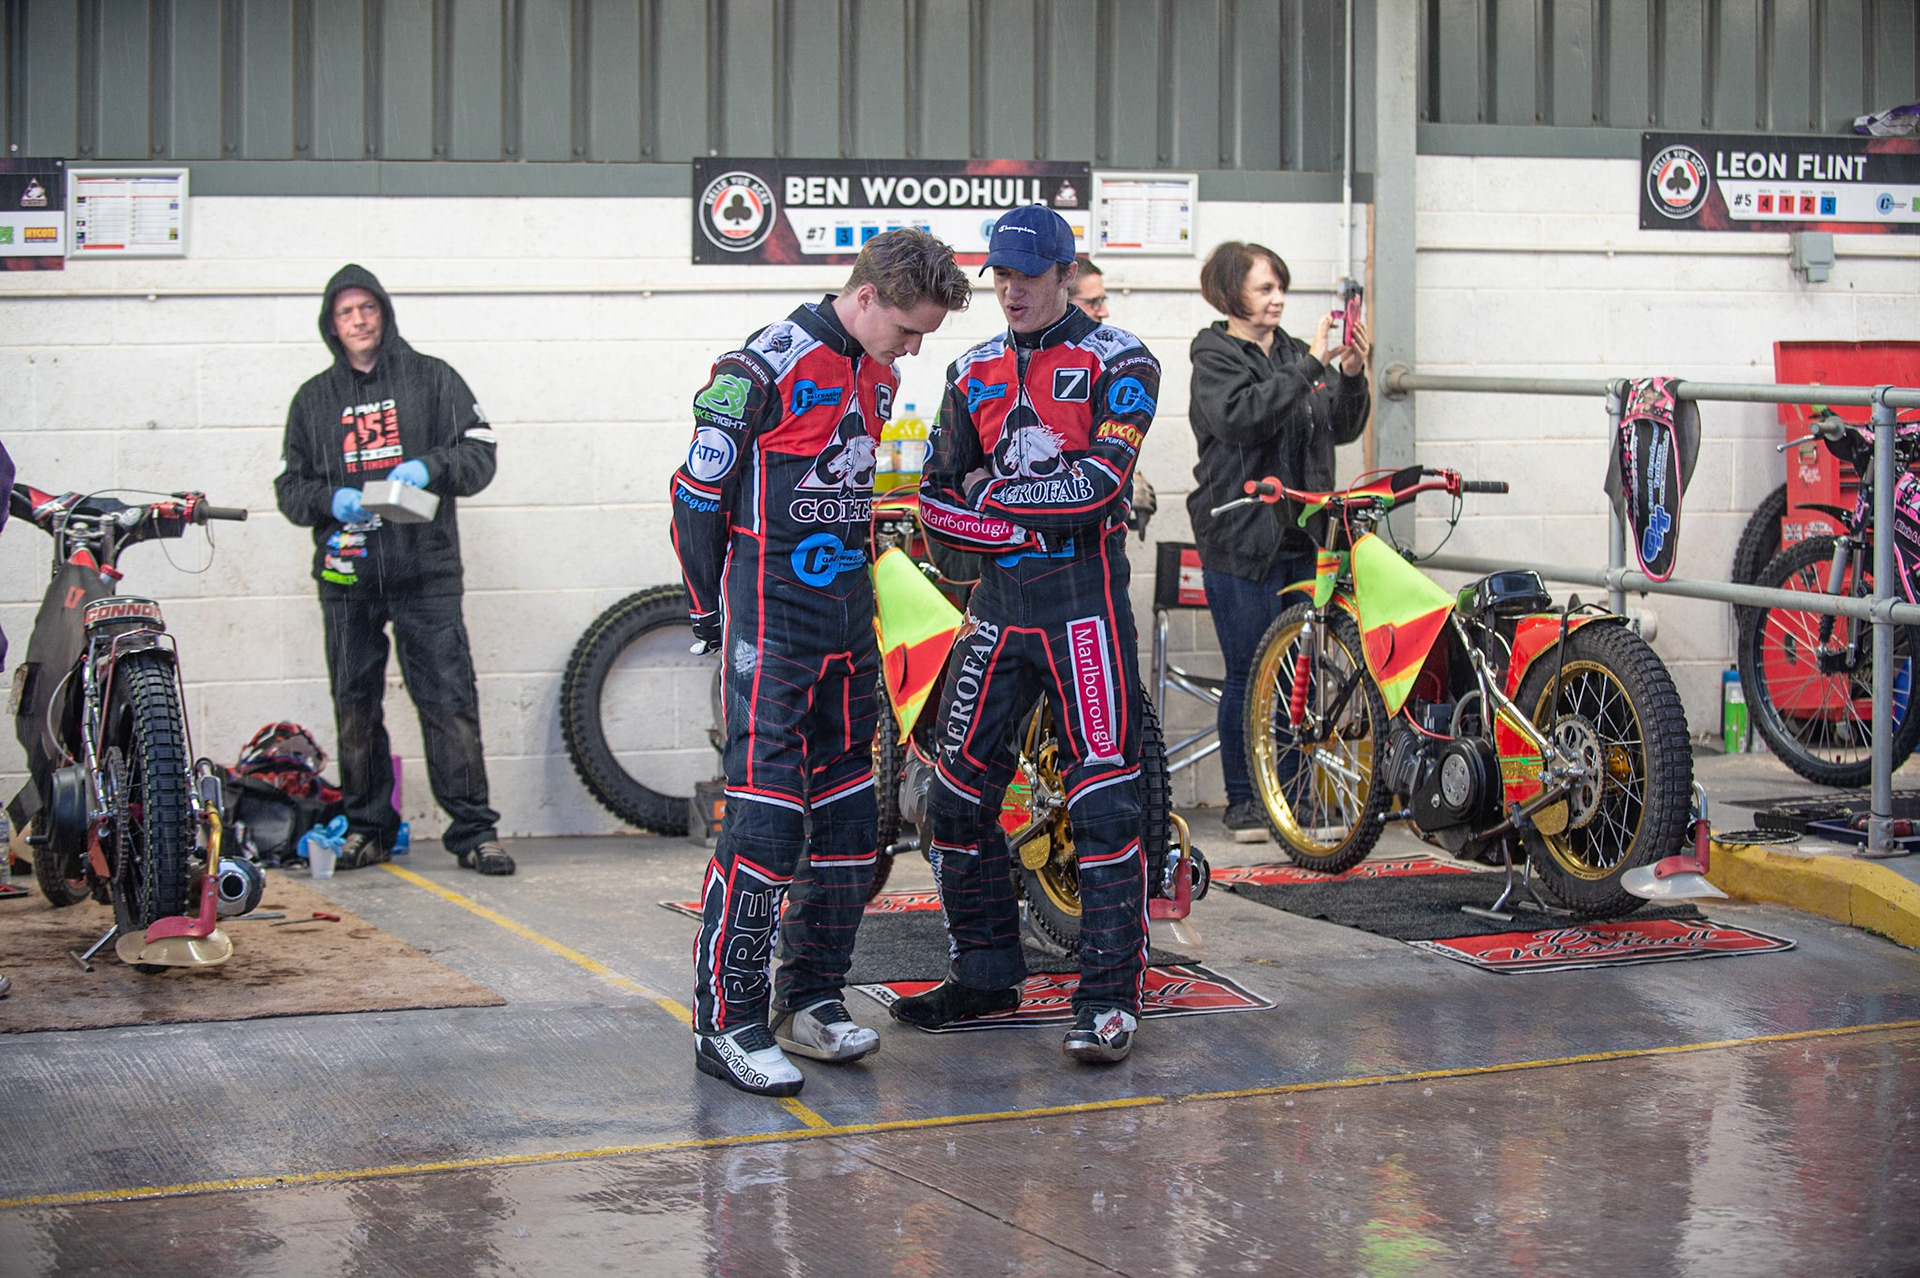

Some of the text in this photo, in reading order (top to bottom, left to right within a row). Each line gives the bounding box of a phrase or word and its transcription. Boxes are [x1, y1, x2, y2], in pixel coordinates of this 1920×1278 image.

[1652, 153, 1672, 176] BELLE
[1673, 149, 1690, 159] VUE
[1716, 151, 1867, 180] LEON FLINT
[729, 176, 751, 186] VUE
[785, 176, 1048, 206] BEN WOODHULL
[1734, 194, 1752, 207] #5
[1762, 197, 1769, 210] 4
[1784, 197, 1789, 210] 1
[1803, 198, 1811, 211] 2
[1824, 198, 1832, 212] 3
[806, 227, 826, 241] #7
[839, 229, 849, 243] 3
[1059, 370, 1085, 398] 7
[879, 386, 892, 417] 2
[1097, 421, 1144, 448] HYCOT
[675, 486, 719, 513] Reggie
[921, 505, 1010, 538] Marlborough
[943, 620, 999, 765] AEROFAB
[1075, 628, 1112, 754] Marlborough
[713, 1036, 770, 1088] daytona
